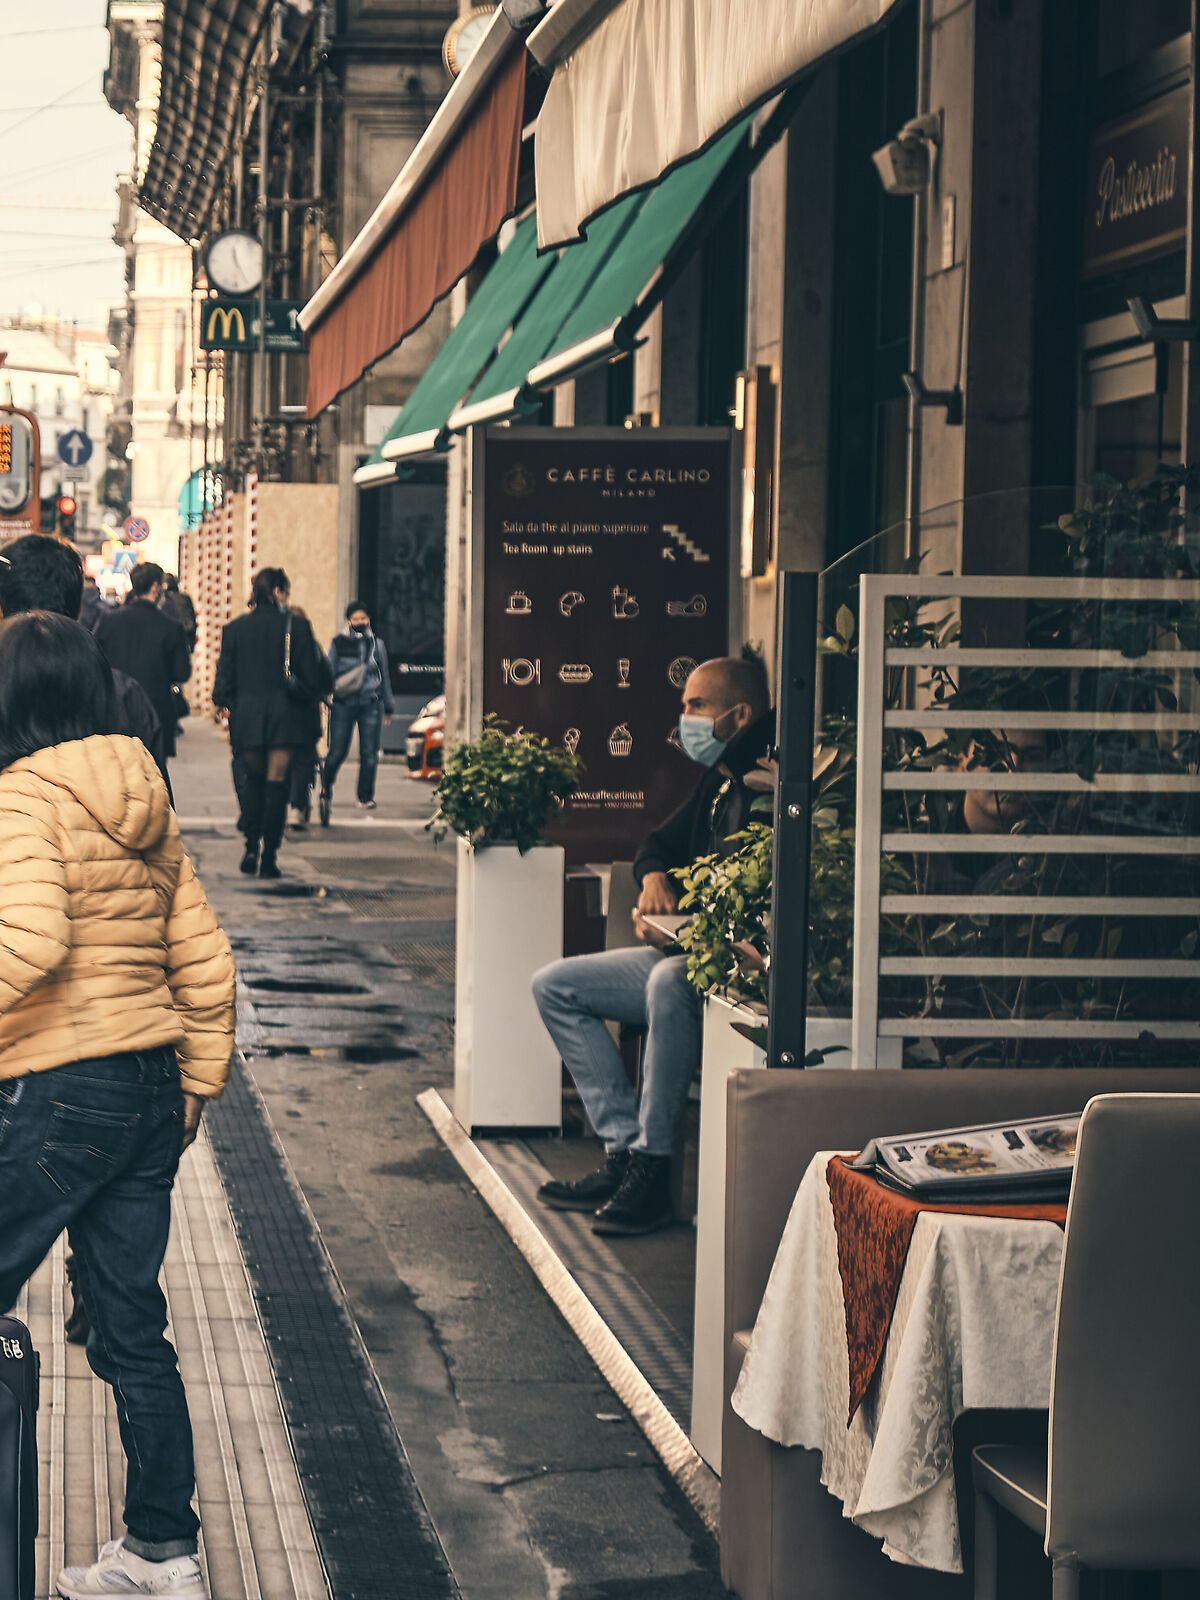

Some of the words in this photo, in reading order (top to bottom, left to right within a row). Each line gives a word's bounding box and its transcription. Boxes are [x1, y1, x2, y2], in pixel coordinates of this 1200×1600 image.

[546, 464, 616, 483] CAFFÈ
[626, 468, 711, 483] CARLINO
[601, 489, 657, 498] MILANO
[503, 520, 524, 533] Sala
[527, 520, 539, 533] da
[542, 520, 558, 533] the
[560, 520, 570, 533] al
[572, 521, 601, 535] piano
[602, 523, 649, 536] superiore
[503, 542, 520, 554] Tea
[522, 542, 548, 554] Room
[553, 545, 565, 556] up
[567, 544, 593, 555] stairs
